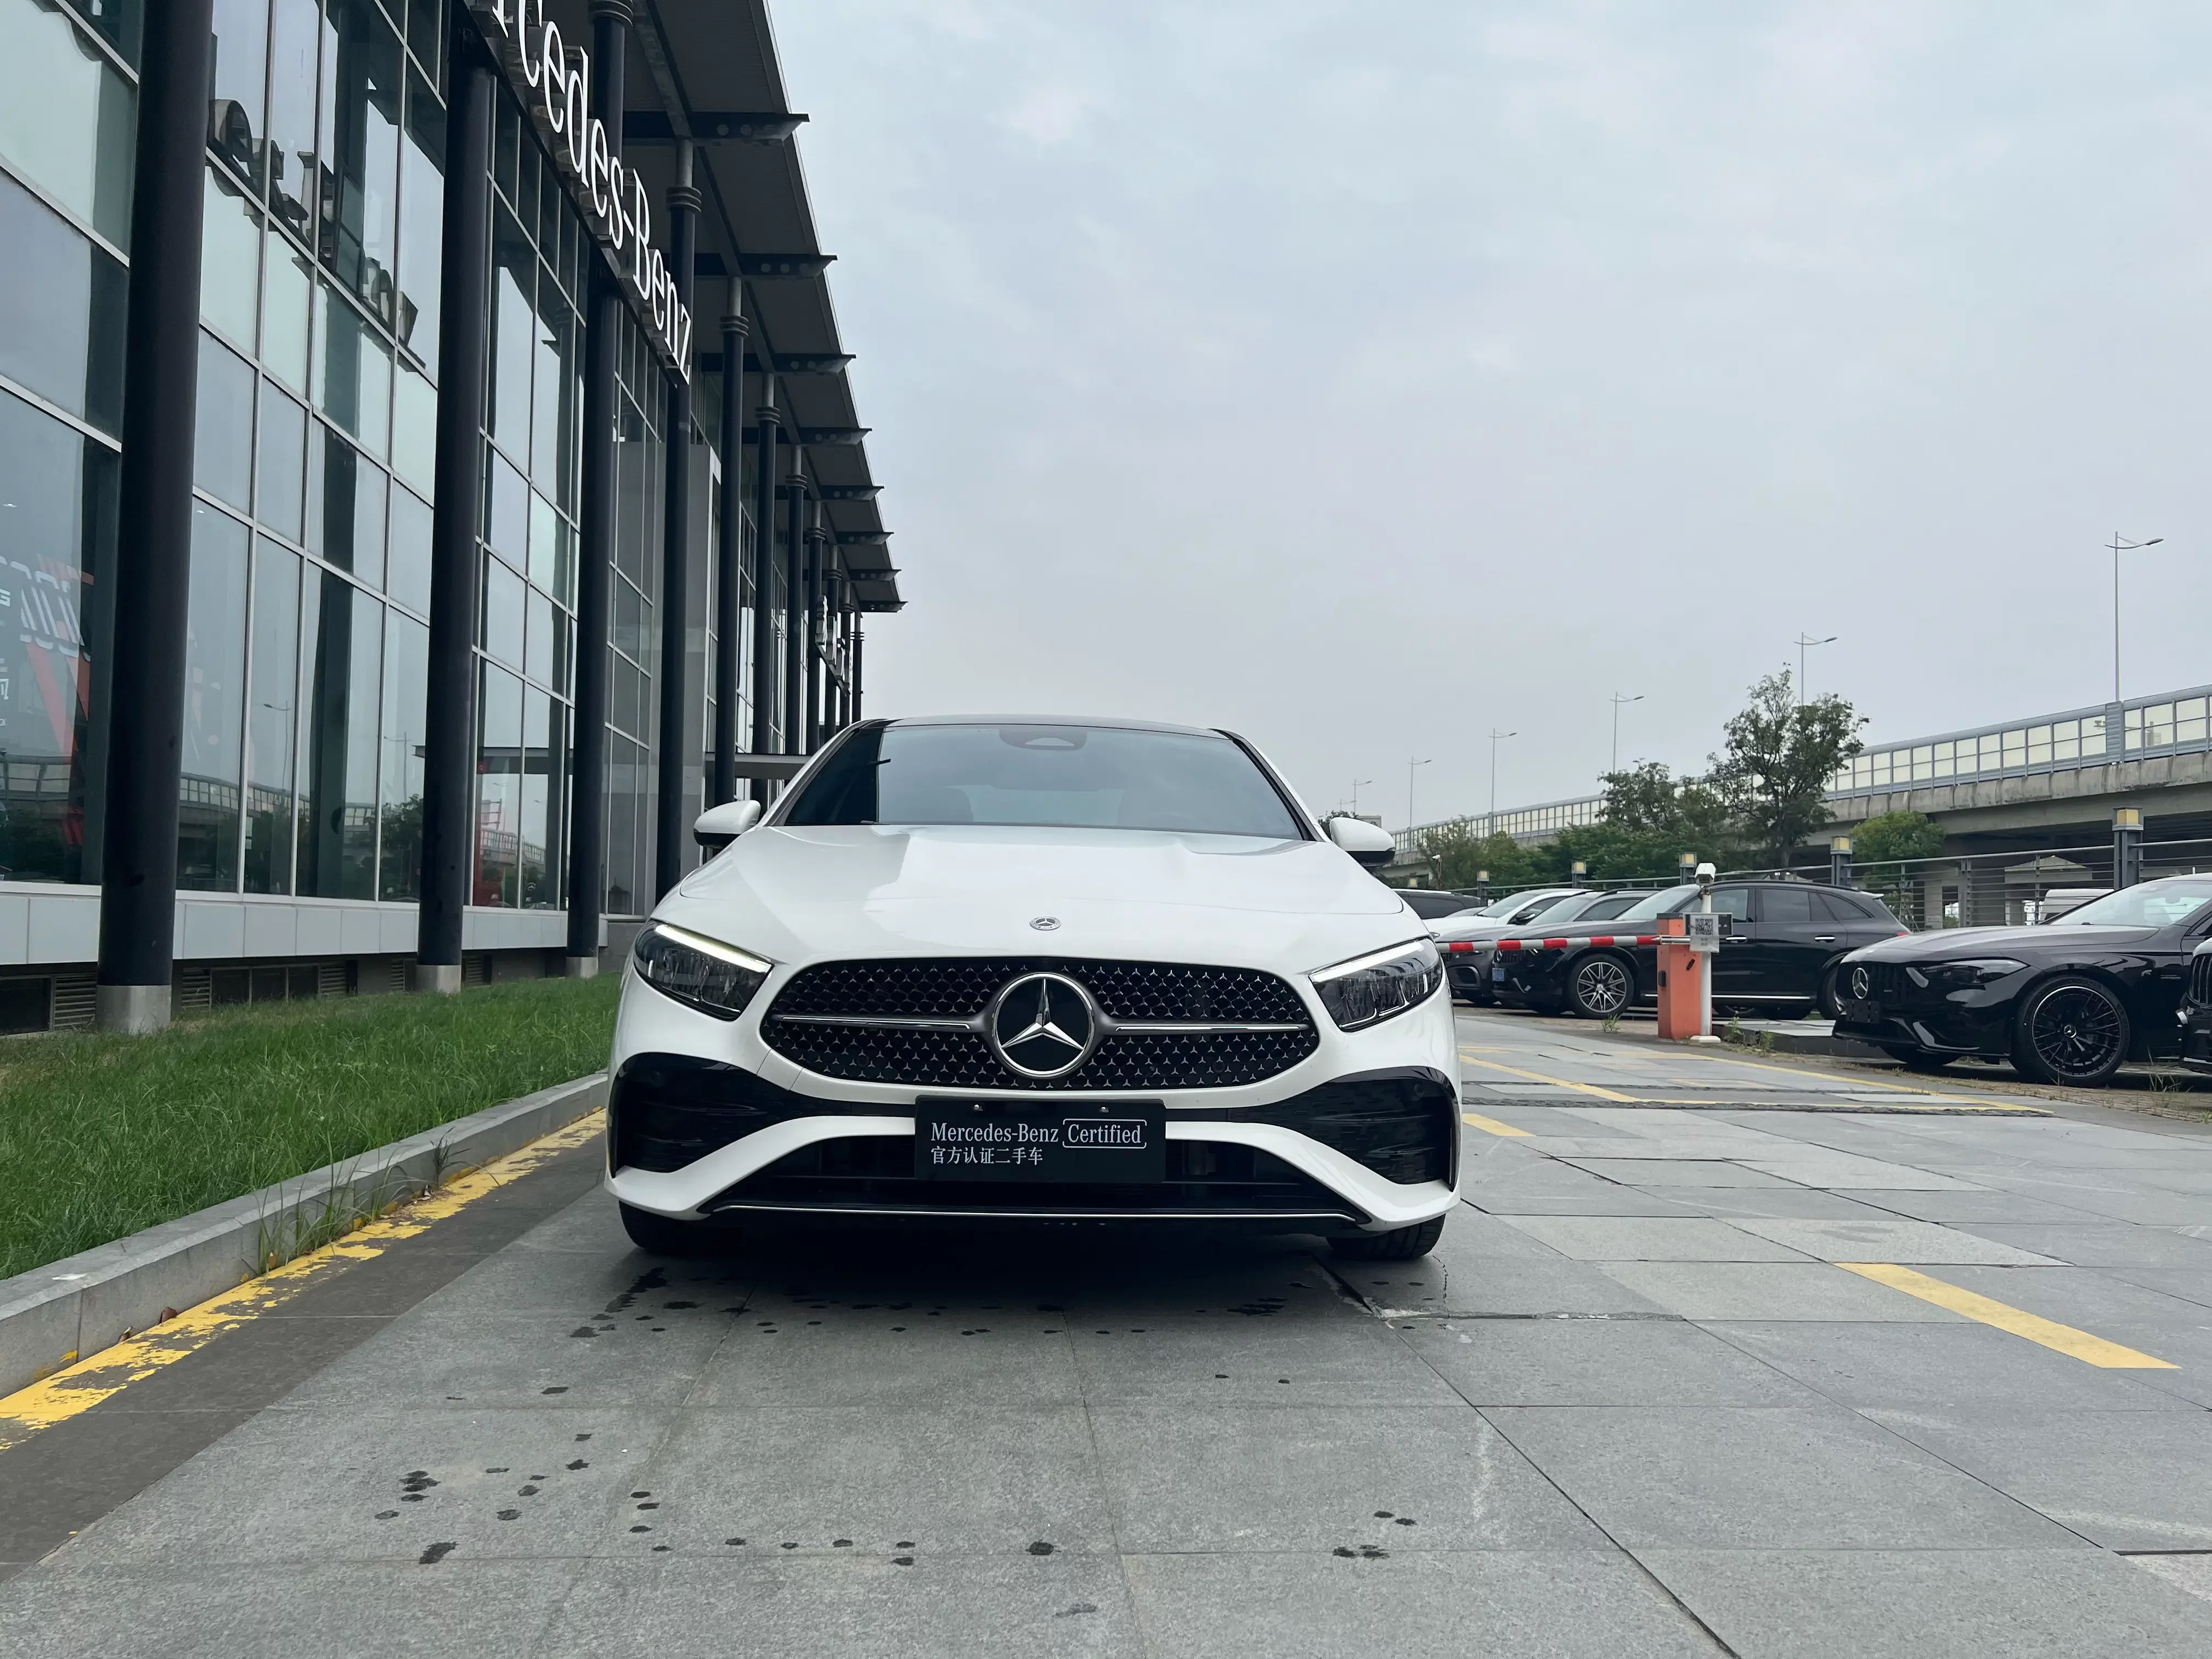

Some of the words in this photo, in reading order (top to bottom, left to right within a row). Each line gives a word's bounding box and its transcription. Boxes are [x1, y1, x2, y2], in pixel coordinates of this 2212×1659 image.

[931, 1122, 1058, 1142] Mercedes-Benz
[1068, 1124, 1141, 1143] Certified
[931, 1146, 1043, 1165] 官方认证二手车
